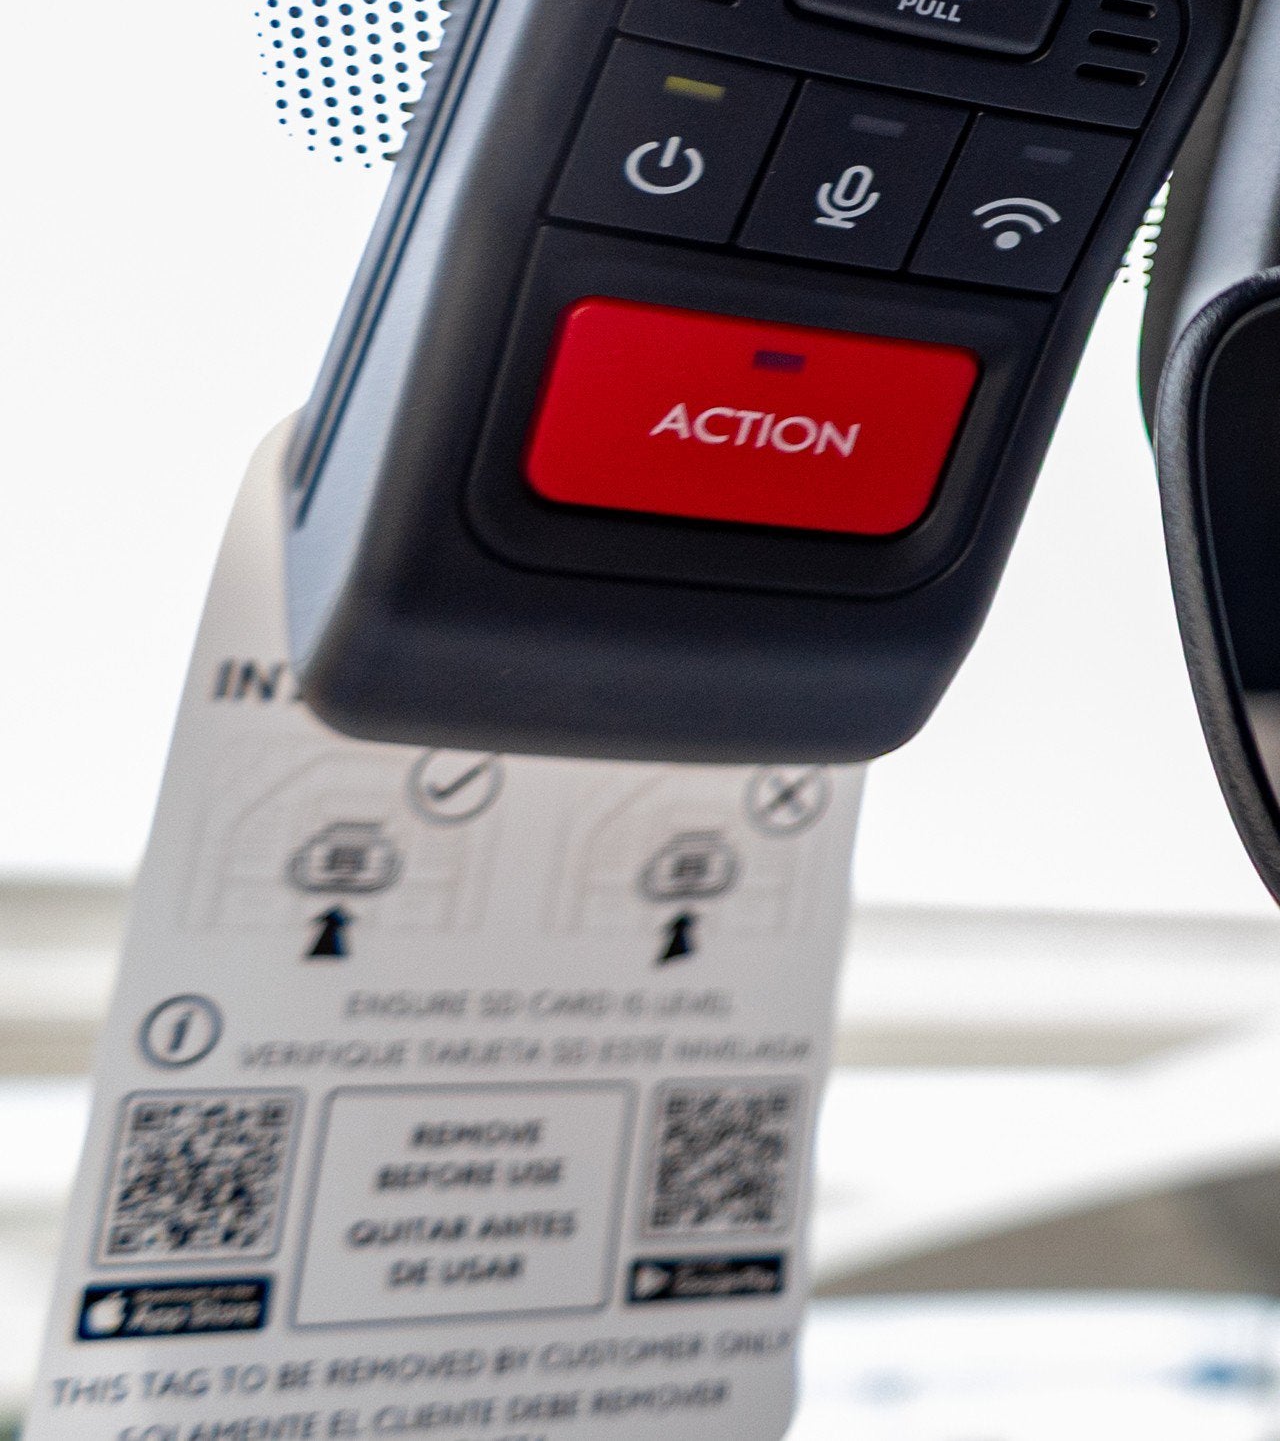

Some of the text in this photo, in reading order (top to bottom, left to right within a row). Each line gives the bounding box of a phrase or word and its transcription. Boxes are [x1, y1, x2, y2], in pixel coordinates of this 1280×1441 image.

[650, 402, 861, 458] ACTION
[213, 657, 303, 701] IN
[342, 989, 468, 1021] ENSURE
[528, 989, 609, 1019] CARD
[240, 1039, 405, 1070] VERIFIQUE
[410, 1118, 544, 1148] REMOVE
[374, 1156, 564, 1192] BEFORE USE
[348, 1209, 577, 1248] QUITAR ANTES
[386, 1252, 525, 1289] DE USAR
[52, 1373, 129, 1408] THIS
[141, 1366, 210, 1399] TAG
[219, 1361, 269, 1395] TO
[276, 1358, 315, 1389] BE
[323, 1346, 487, 1387] REMOVED
[493, 1343, 531, 1375] BY
[537, 1331, 704, 1370] CUSTOMER
[327, 1406, 361, 1437] EL
[372, 1395, 496, 1435] CLIENTE
[505, 1388, 582, 1424] DEBE
[590, 1377, 730, 1417] REMOVER
